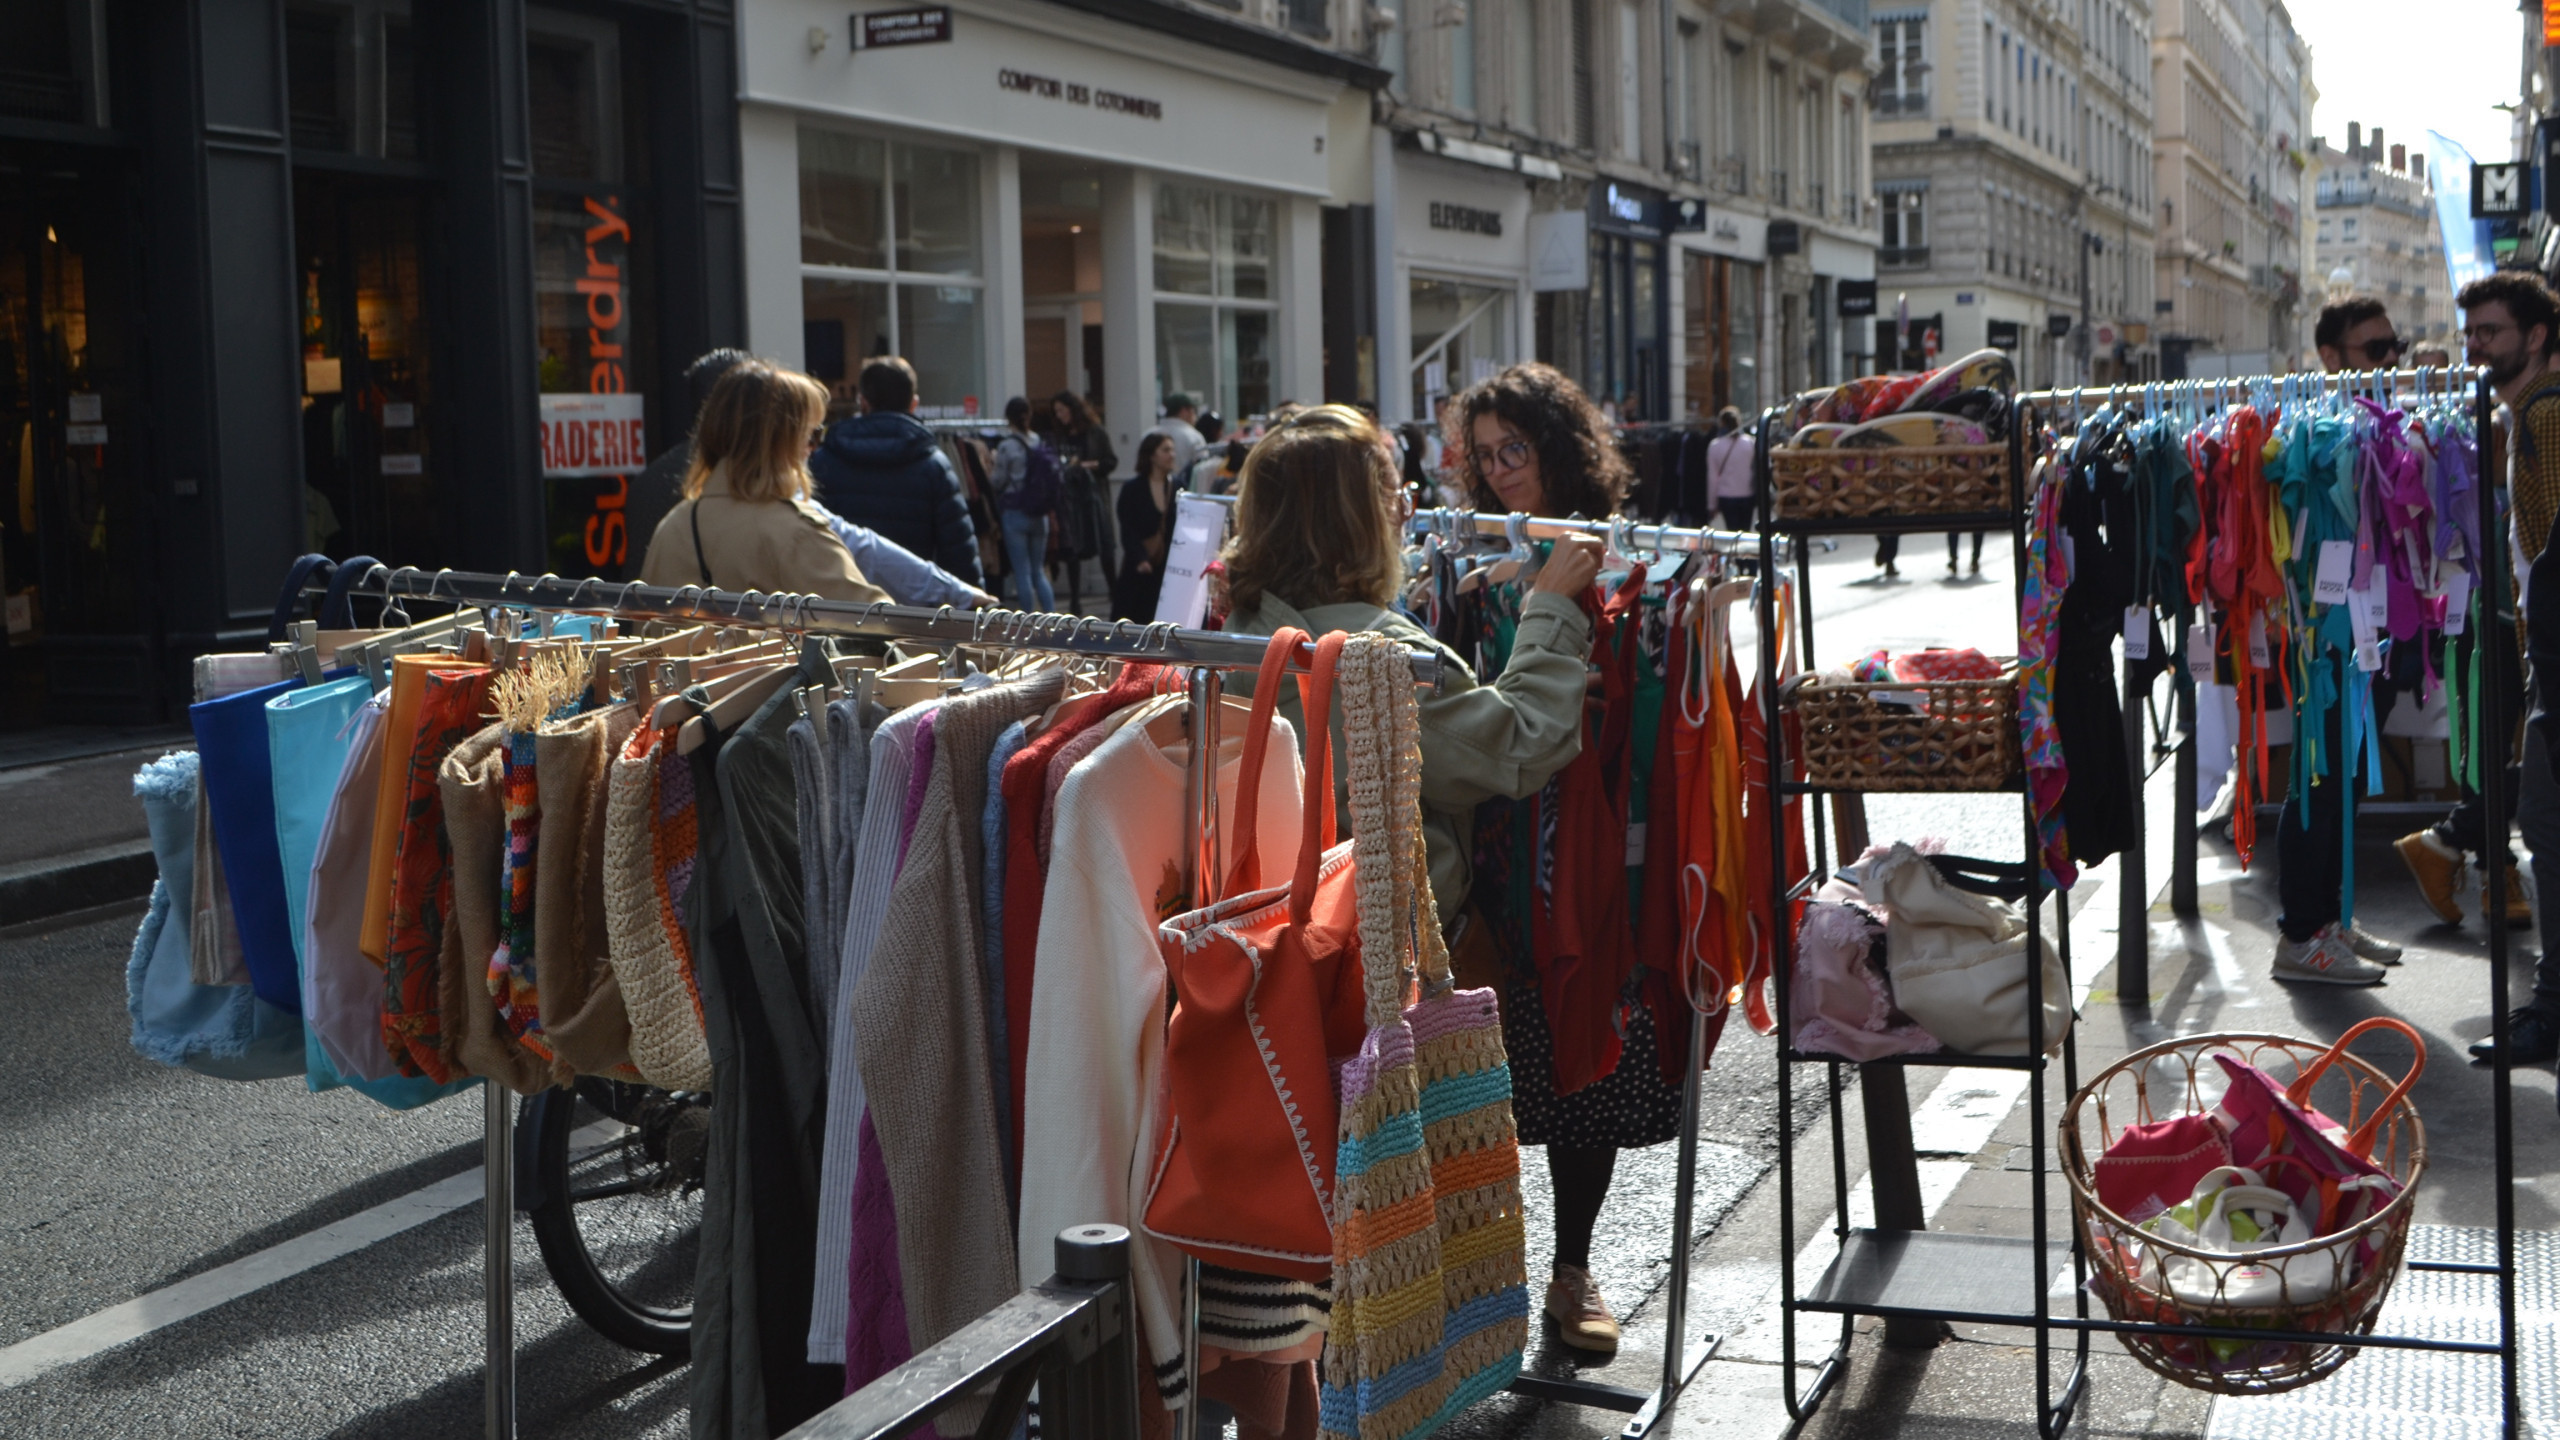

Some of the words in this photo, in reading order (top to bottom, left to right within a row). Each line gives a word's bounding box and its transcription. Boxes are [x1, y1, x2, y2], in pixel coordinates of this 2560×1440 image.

[998, 68, 1062, 98] COMPTOIR
[1066, 83, 1089, 105] DES
[1095, 89, 1162, 120] COTONNIERS
[575, 195, 631, 567] Suerdry.
